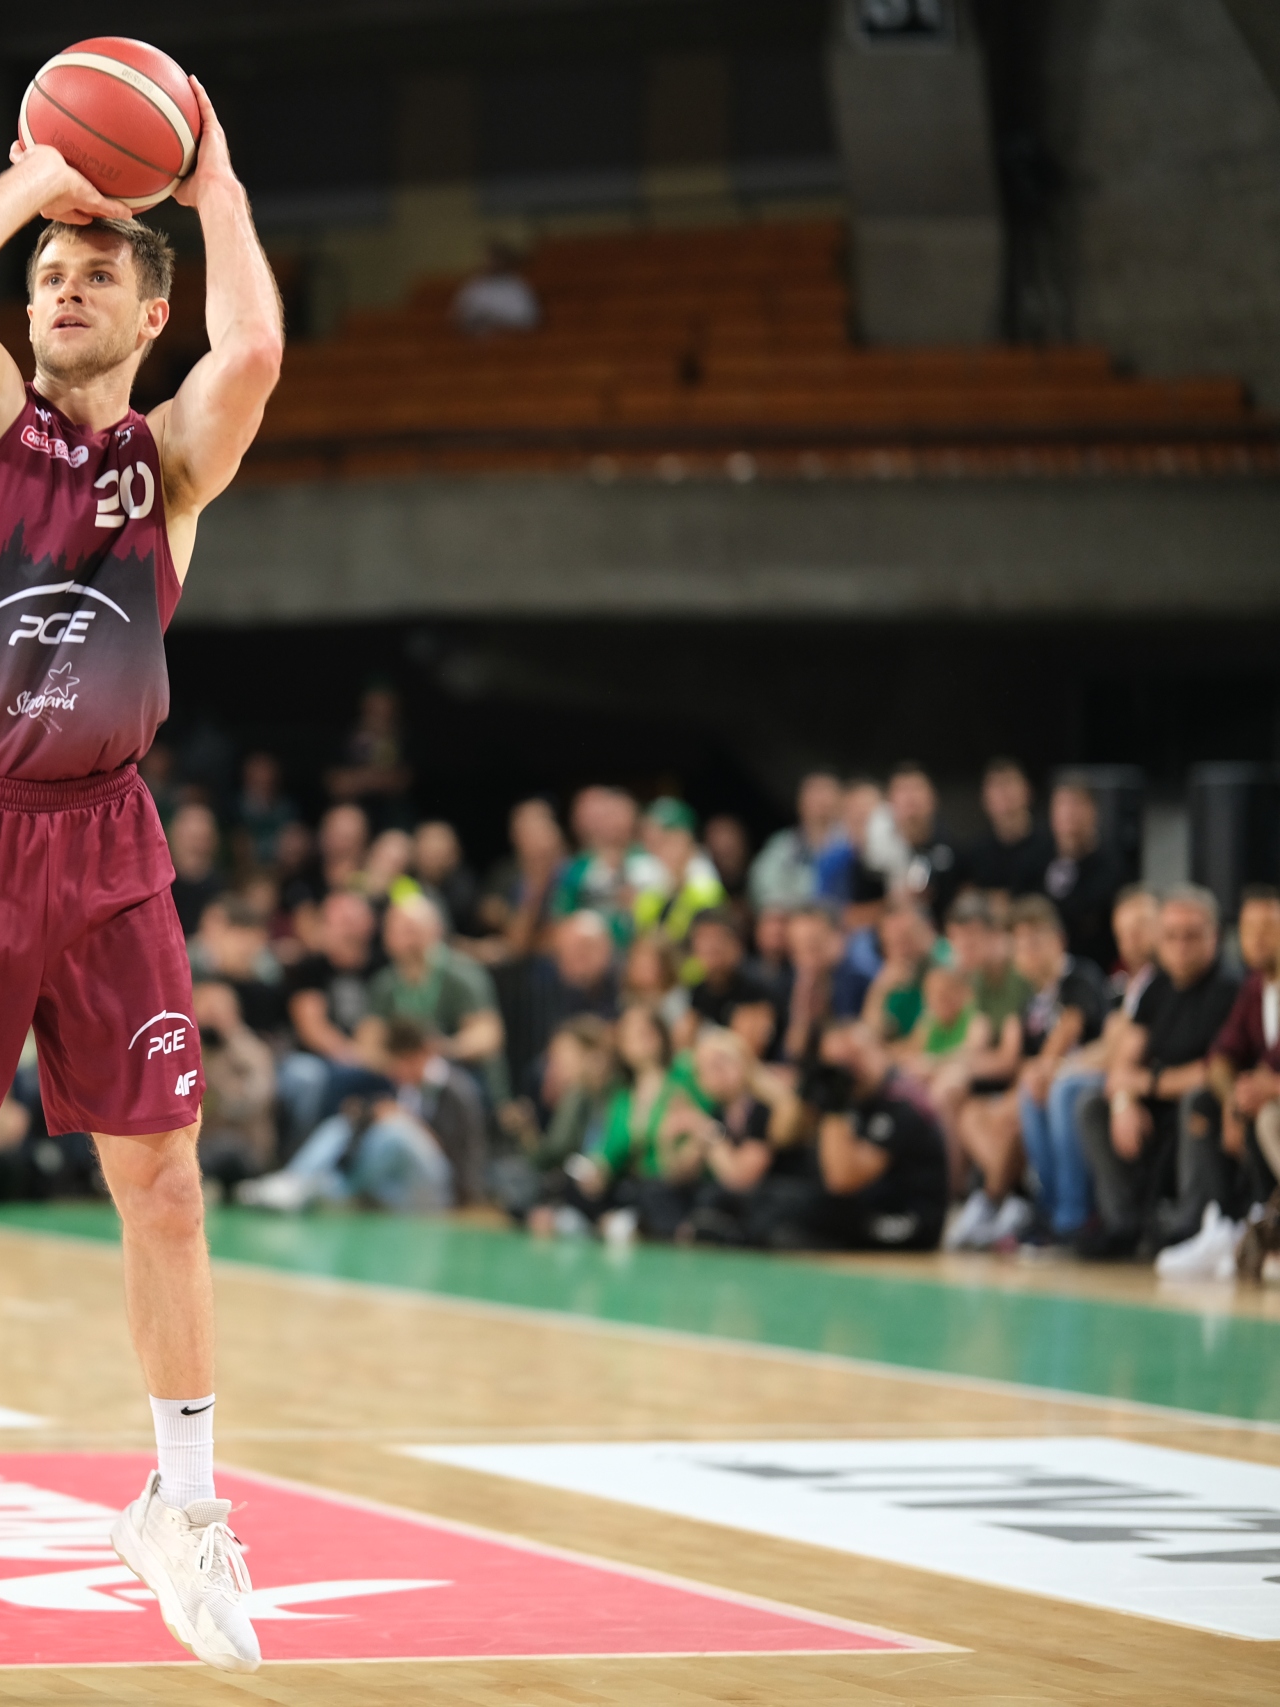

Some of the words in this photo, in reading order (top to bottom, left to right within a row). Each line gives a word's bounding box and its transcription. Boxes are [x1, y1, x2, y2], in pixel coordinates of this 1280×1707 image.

[93, 461, 155, 528] 20
[8, 610, 96, 646] PGE
[147, 1027, 186, 1060] PGE
